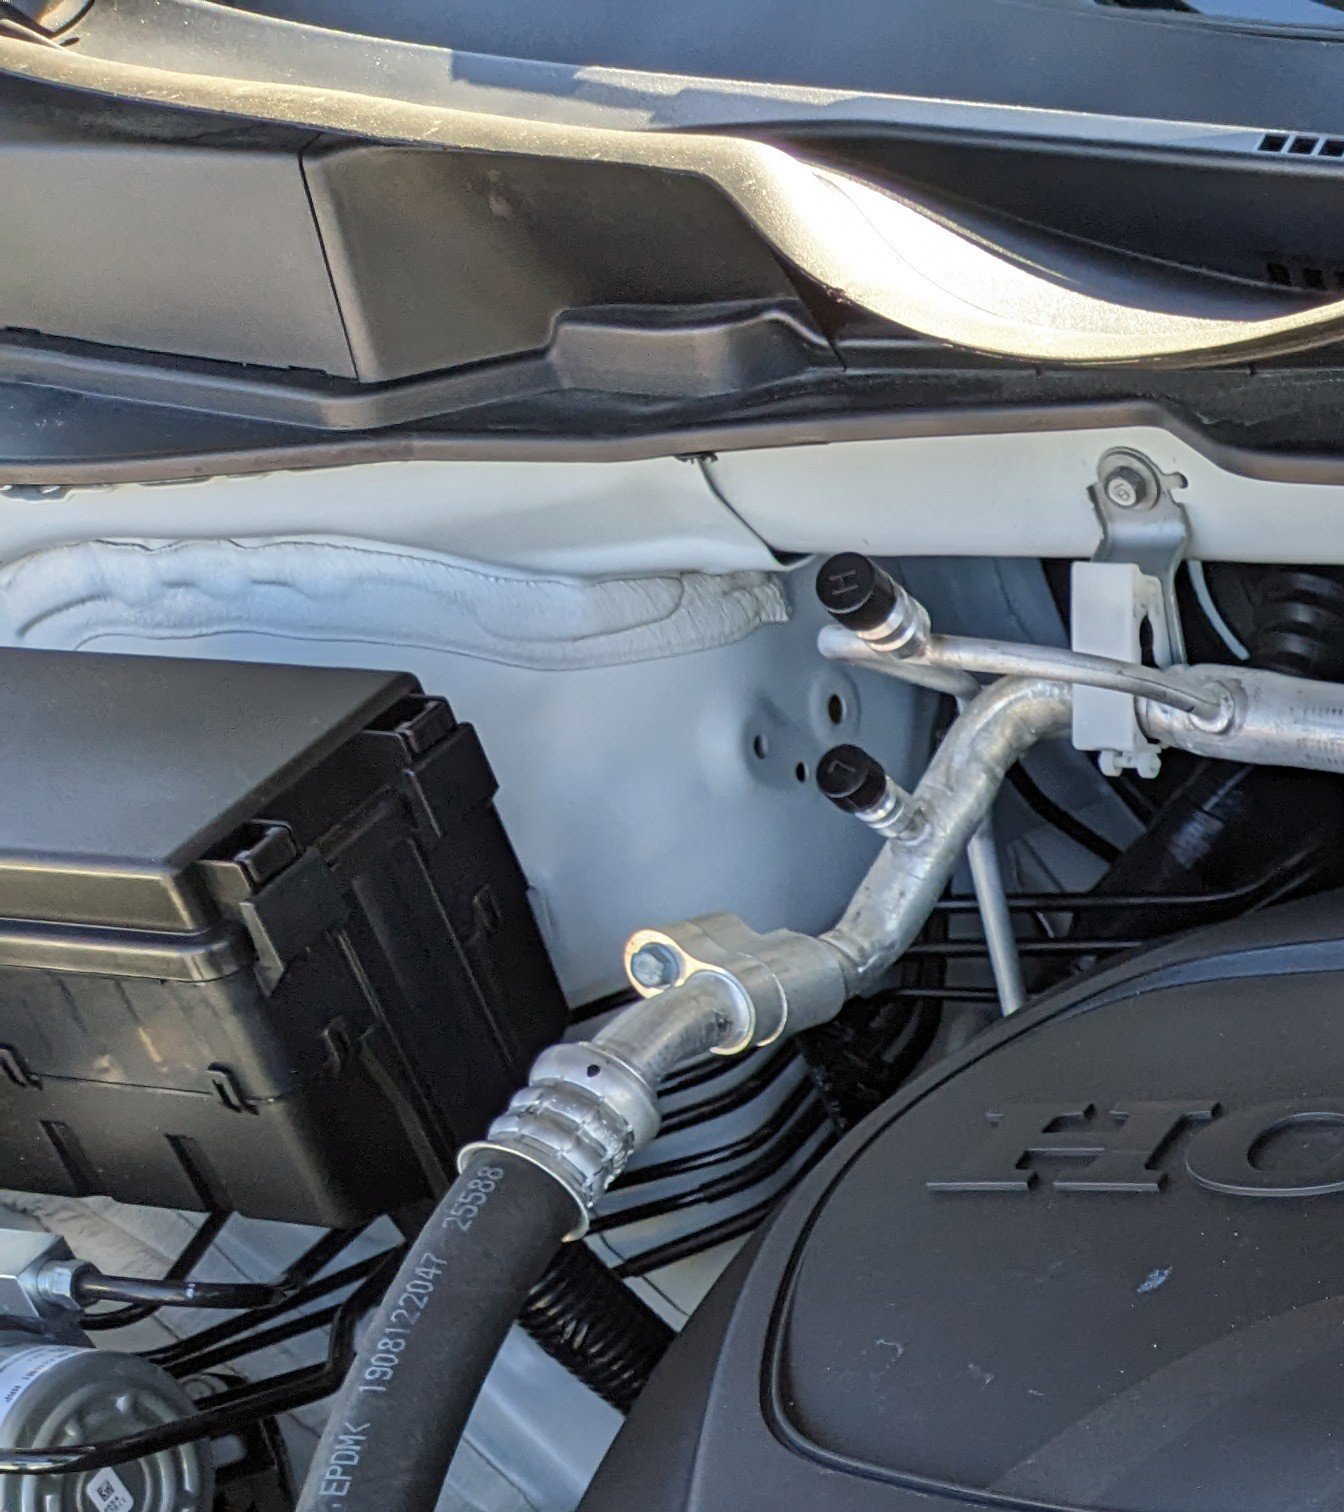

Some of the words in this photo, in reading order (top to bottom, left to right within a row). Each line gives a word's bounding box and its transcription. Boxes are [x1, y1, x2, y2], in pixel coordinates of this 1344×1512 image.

[826, 567, 859, 597] H
[359, 1252, 448, 1393] 1908122047
[442, 1165, 505, 1232] 25588
